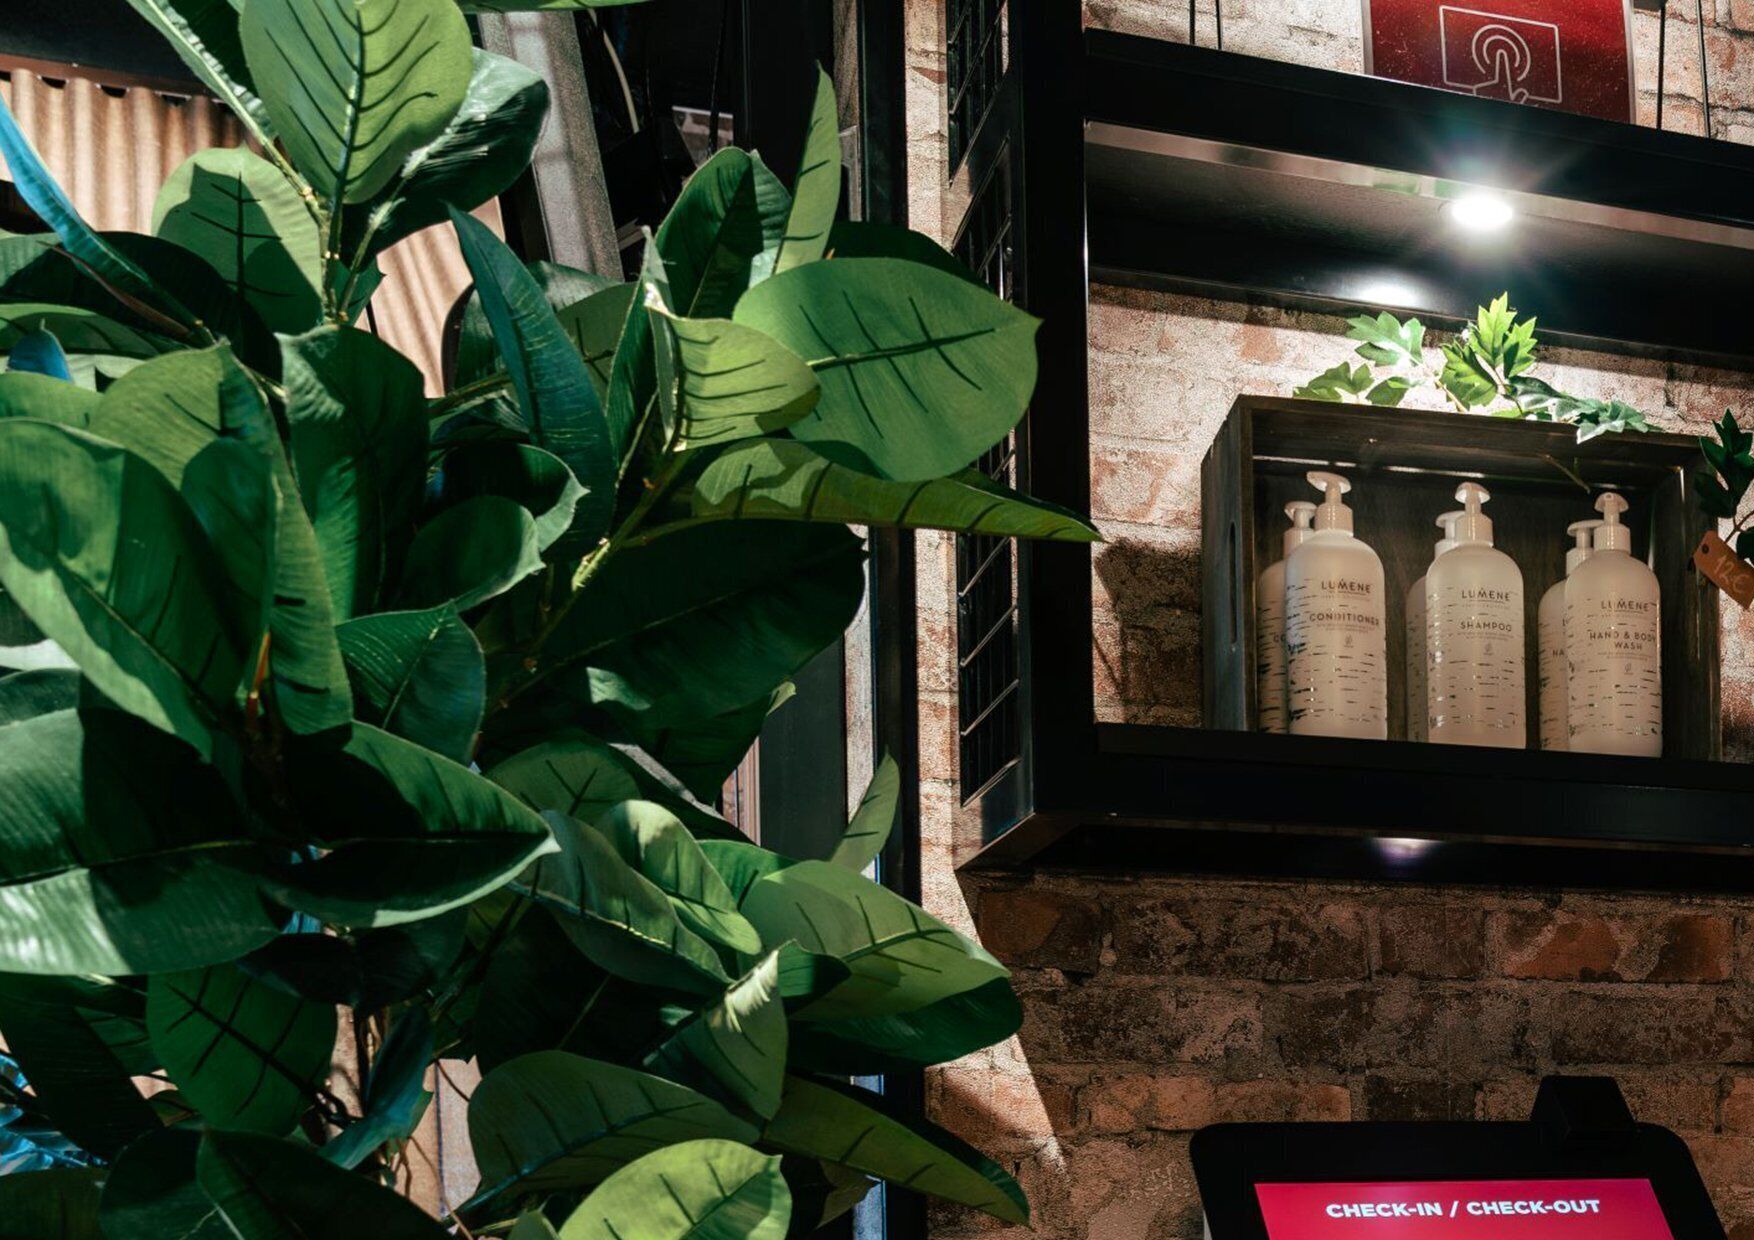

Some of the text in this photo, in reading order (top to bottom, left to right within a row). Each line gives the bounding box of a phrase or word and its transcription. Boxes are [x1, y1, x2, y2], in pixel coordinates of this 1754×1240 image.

[1321, 580, 1371, 593] LUMENE
[1461, 588, 1511, 601] LUMENE
[1309, 613, 1380, 626] CONDITIONER
[1460, 621, 1512, 632] SHAMPOO
[1589, 631, 1620, 640] HAND
[1623, 631, 1630, 640] &
[1614, 641, 1642, 650] WASH
[1325, 1199, 1601, 1218] CHECK-IN / CHECK-OUT
